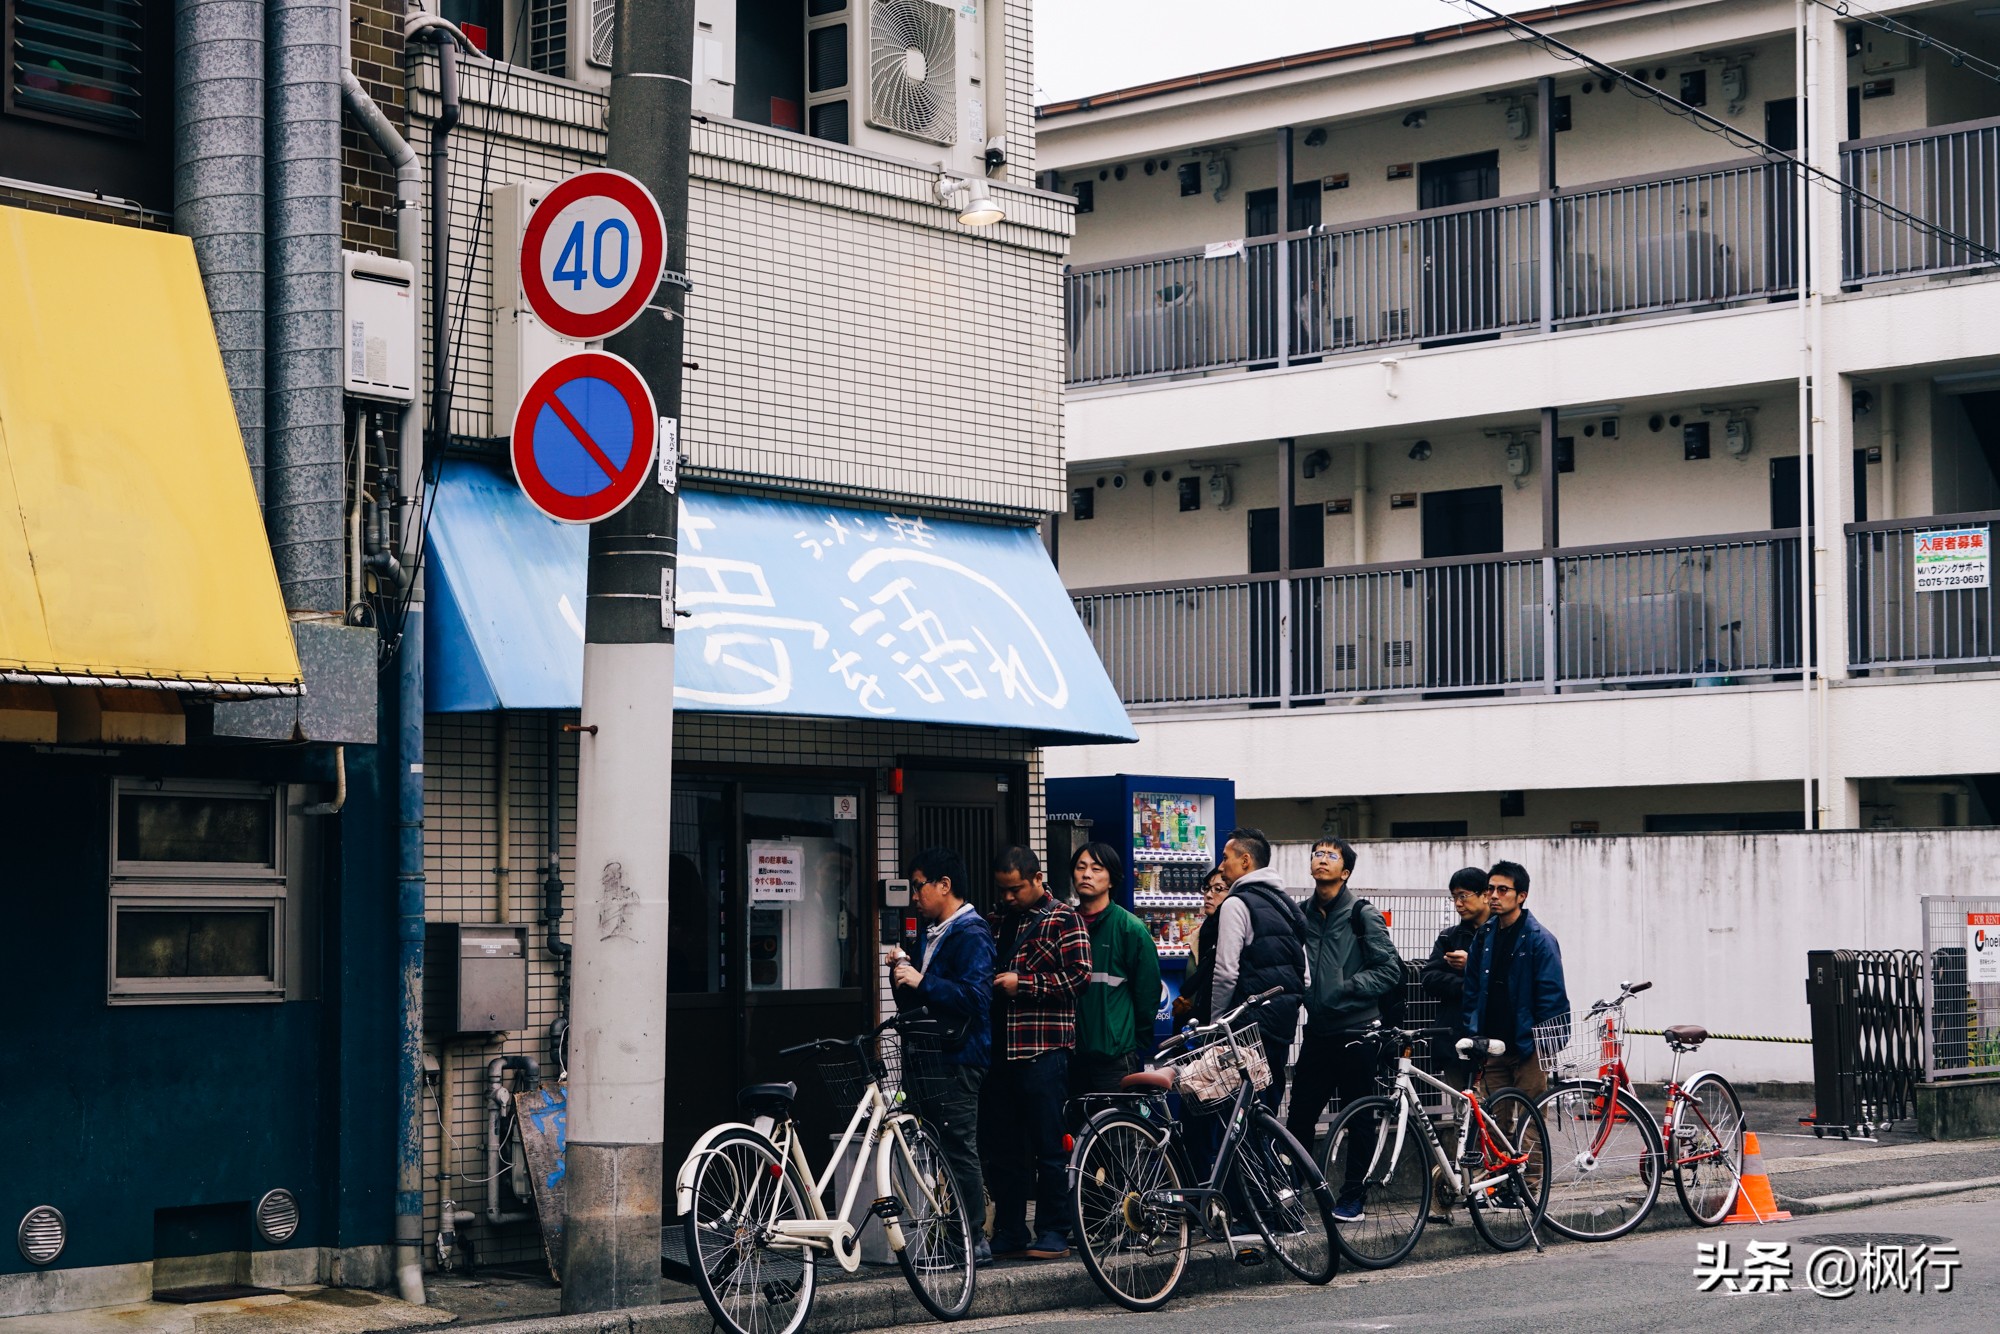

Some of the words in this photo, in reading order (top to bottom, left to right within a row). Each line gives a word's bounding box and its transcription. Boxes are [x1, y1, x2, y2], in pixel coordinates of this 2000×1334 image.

[552, 218, 630, 290] 40
[1919, 534, 1983, 552] 入居者募集
[1917, 561, 1985, 575] Mハウジングサポート
[1973, 914, 1985, 925] FOR
[1985, 914, 2000, 925] RENT
[1415, 1101, 1440, 1148] GIANT
